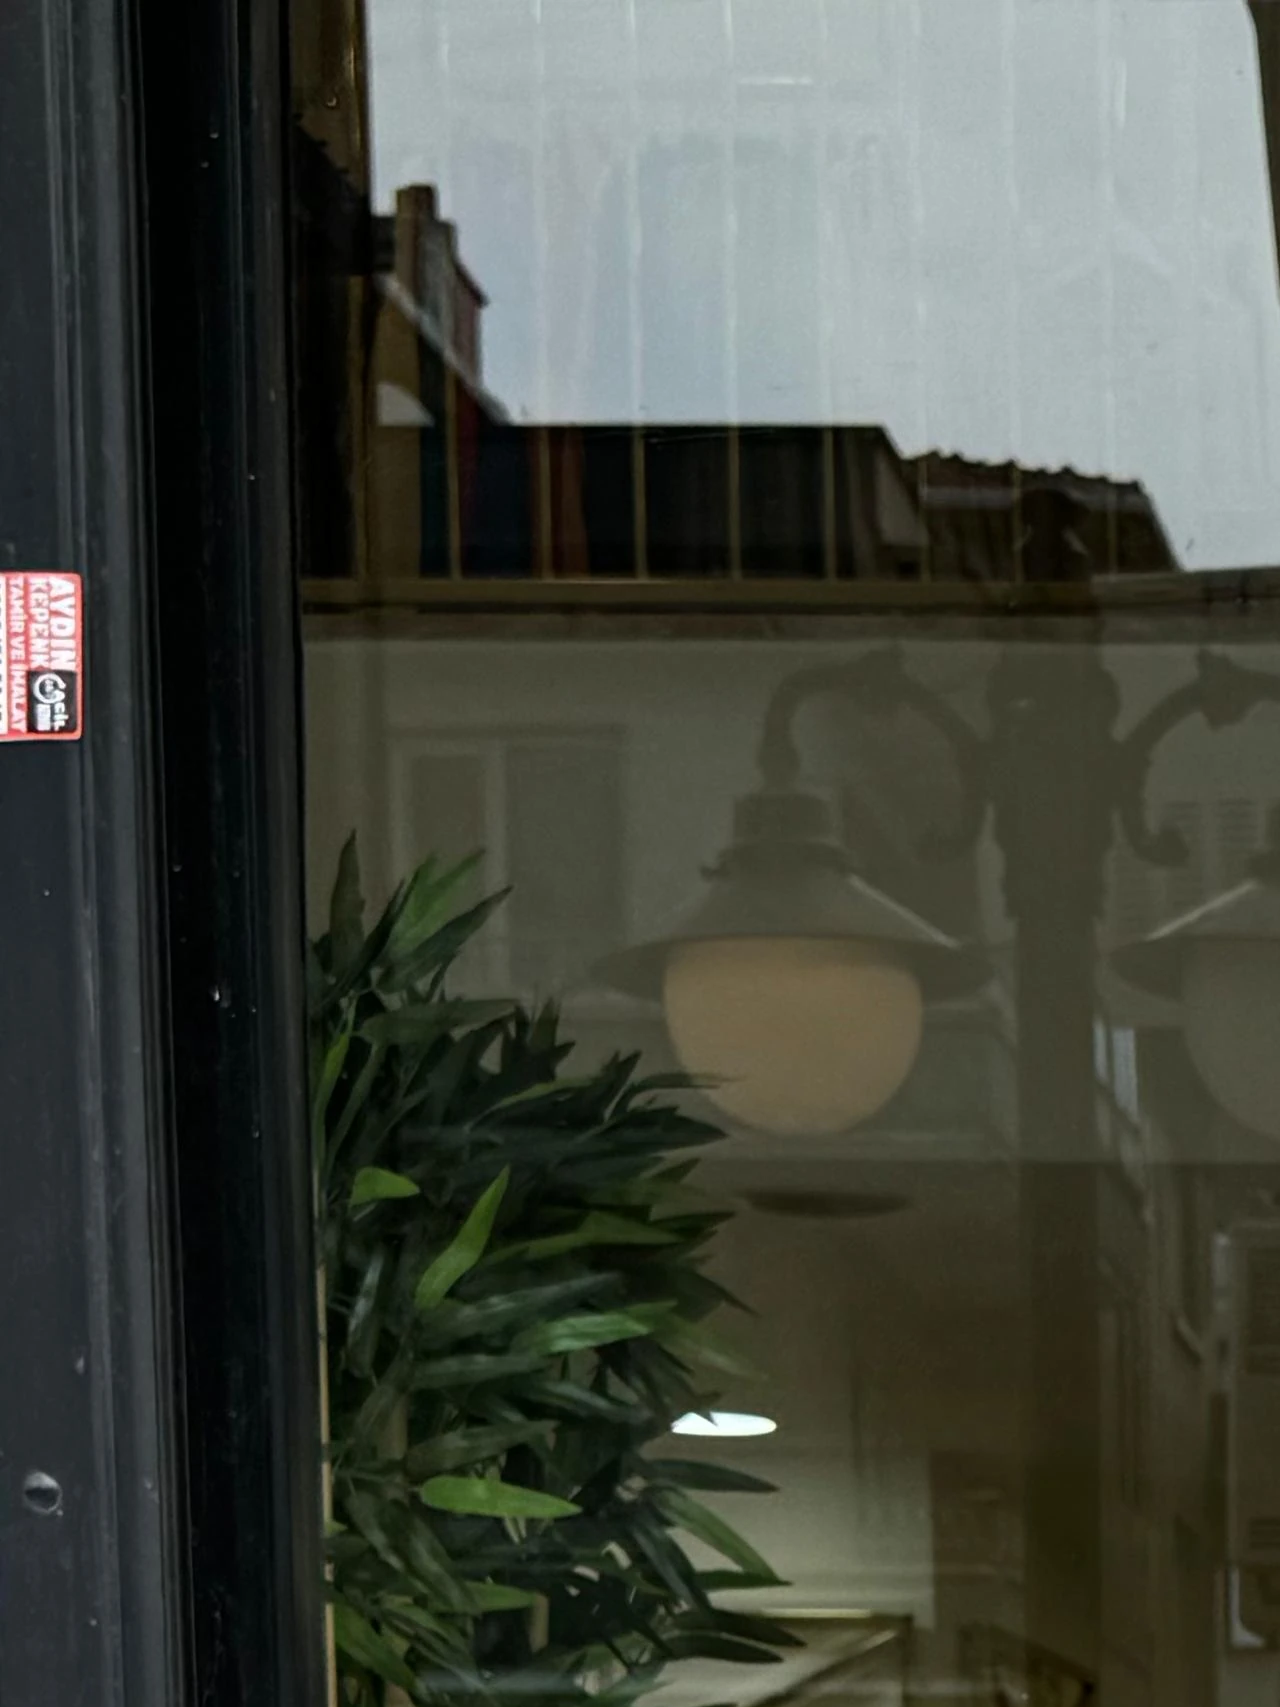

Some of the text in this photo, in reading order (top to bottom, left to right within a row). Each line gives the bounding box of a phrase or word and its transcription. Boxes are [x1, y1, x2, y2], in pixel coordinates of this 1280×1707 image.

[11, 636, 26, 659] VE
[29, 577, 50, 670] KEPENK
[49, 577, 76, 670] AYDIN
